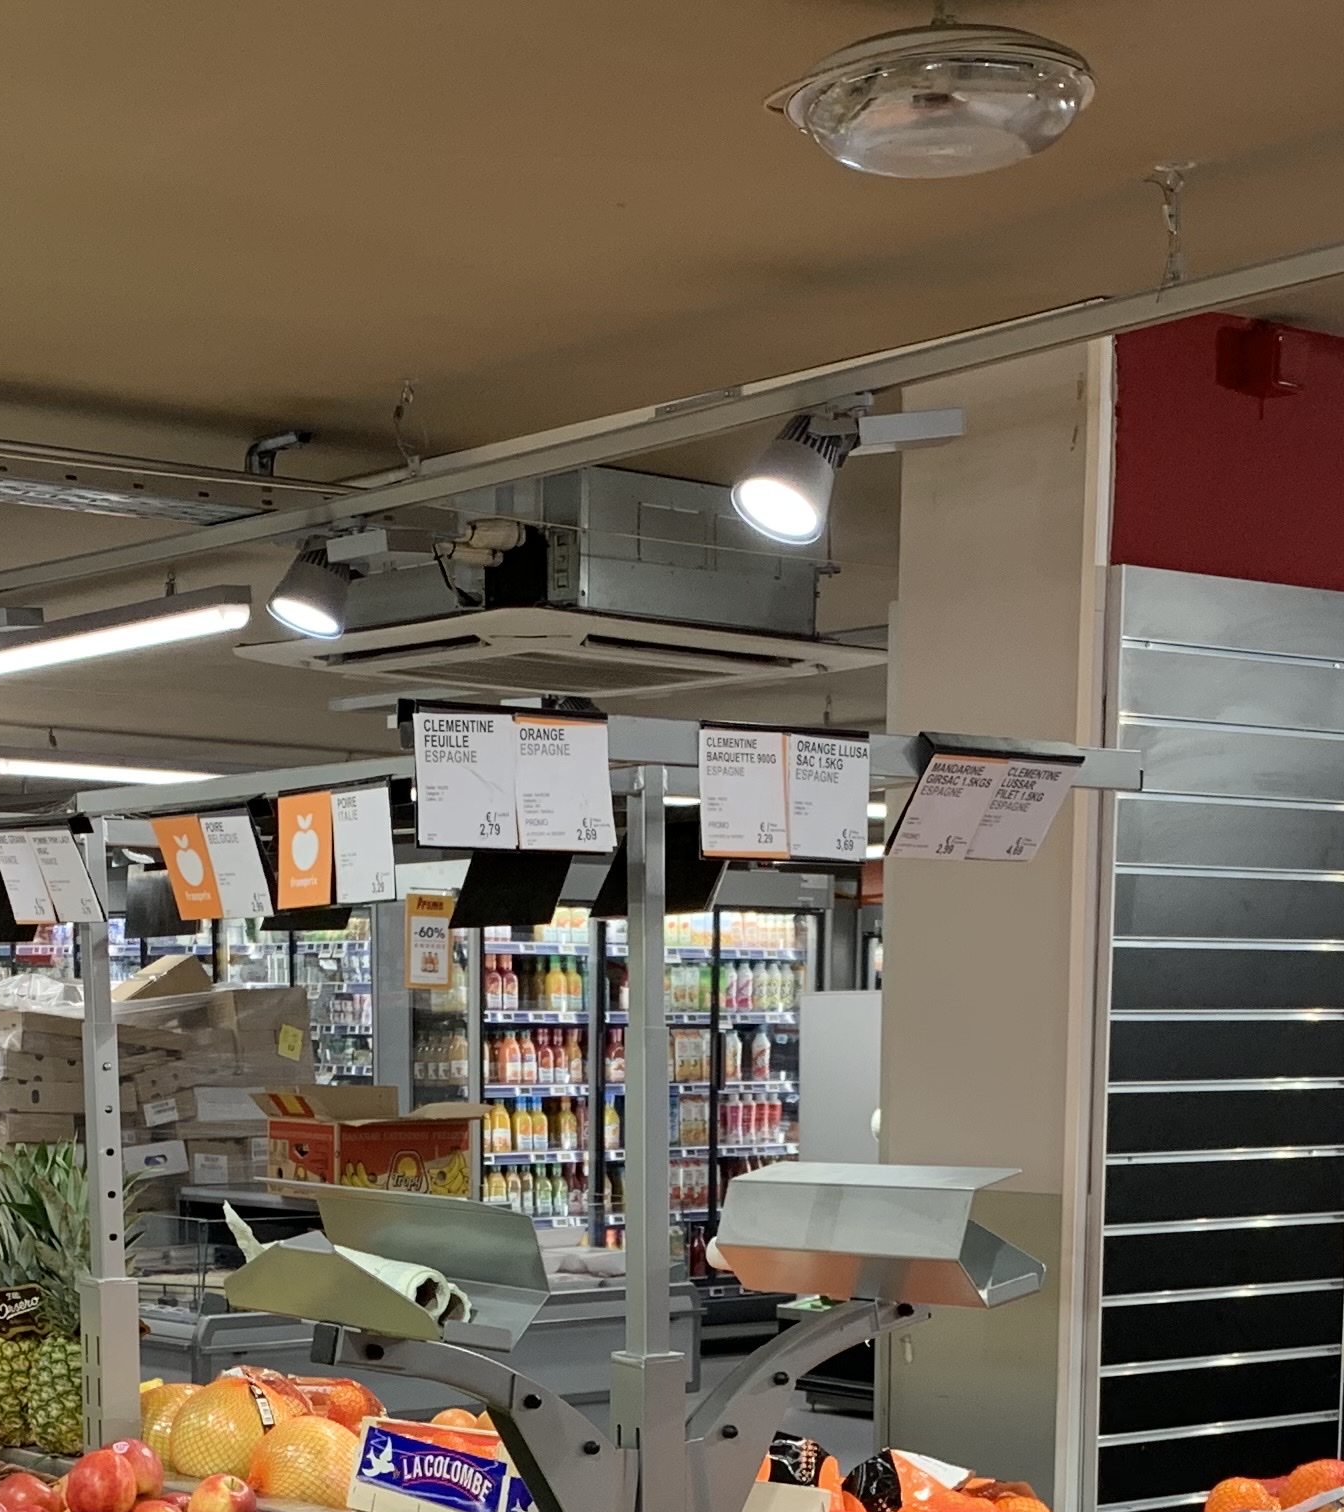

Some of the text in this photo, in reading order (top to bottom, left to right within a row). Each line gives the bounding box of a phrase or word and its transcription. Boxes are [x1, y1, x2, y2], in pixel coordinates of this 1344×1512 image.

[424, 719, 494, 733] CLEMENTINE
[520, 728, 564, 741] ORANGE
[424, 735, 469, 748] FEUILLE
[706, 737, 757, 749] CLEMENTINE
[520, 743, 570, 756] ESPAGNE
[797, 740, 868, 759] ORANGE LLUSA
[425, 750, 477, 763] ESPAGNE
[706, 752, 777, 764] BARQUETTE 900G
[796, 754, 843, 770] SAC 1.5KG
[706, 766, 745, 777] ESPAGNE
[931, 762, 986, 776] MANDARINE
[1007, 767, 1062, 781] CLEMENTINE
[795, 768, 839, 784] ESPAGNE
[925, 773, 961, 785] GIRSAC
[1001, 778, 1037, 790] LUSSAR
[920, 786, 964, 798] ESPAGNE
[995, 789, 1020, 800] FILET
[337, 797, 357, 808] POIRE
[989, 800, 1031, 812] ESPAGNE
[337, 808, 358, 821] ITALIE
[205, 821, 224, 832] POIRE
[480, 823, 500, 837] 2,79
[207, 832, 240, 844] BELGIQUE
[577, 828, 597, 842] 2,69
[414, 926, 445, 939] -60%
